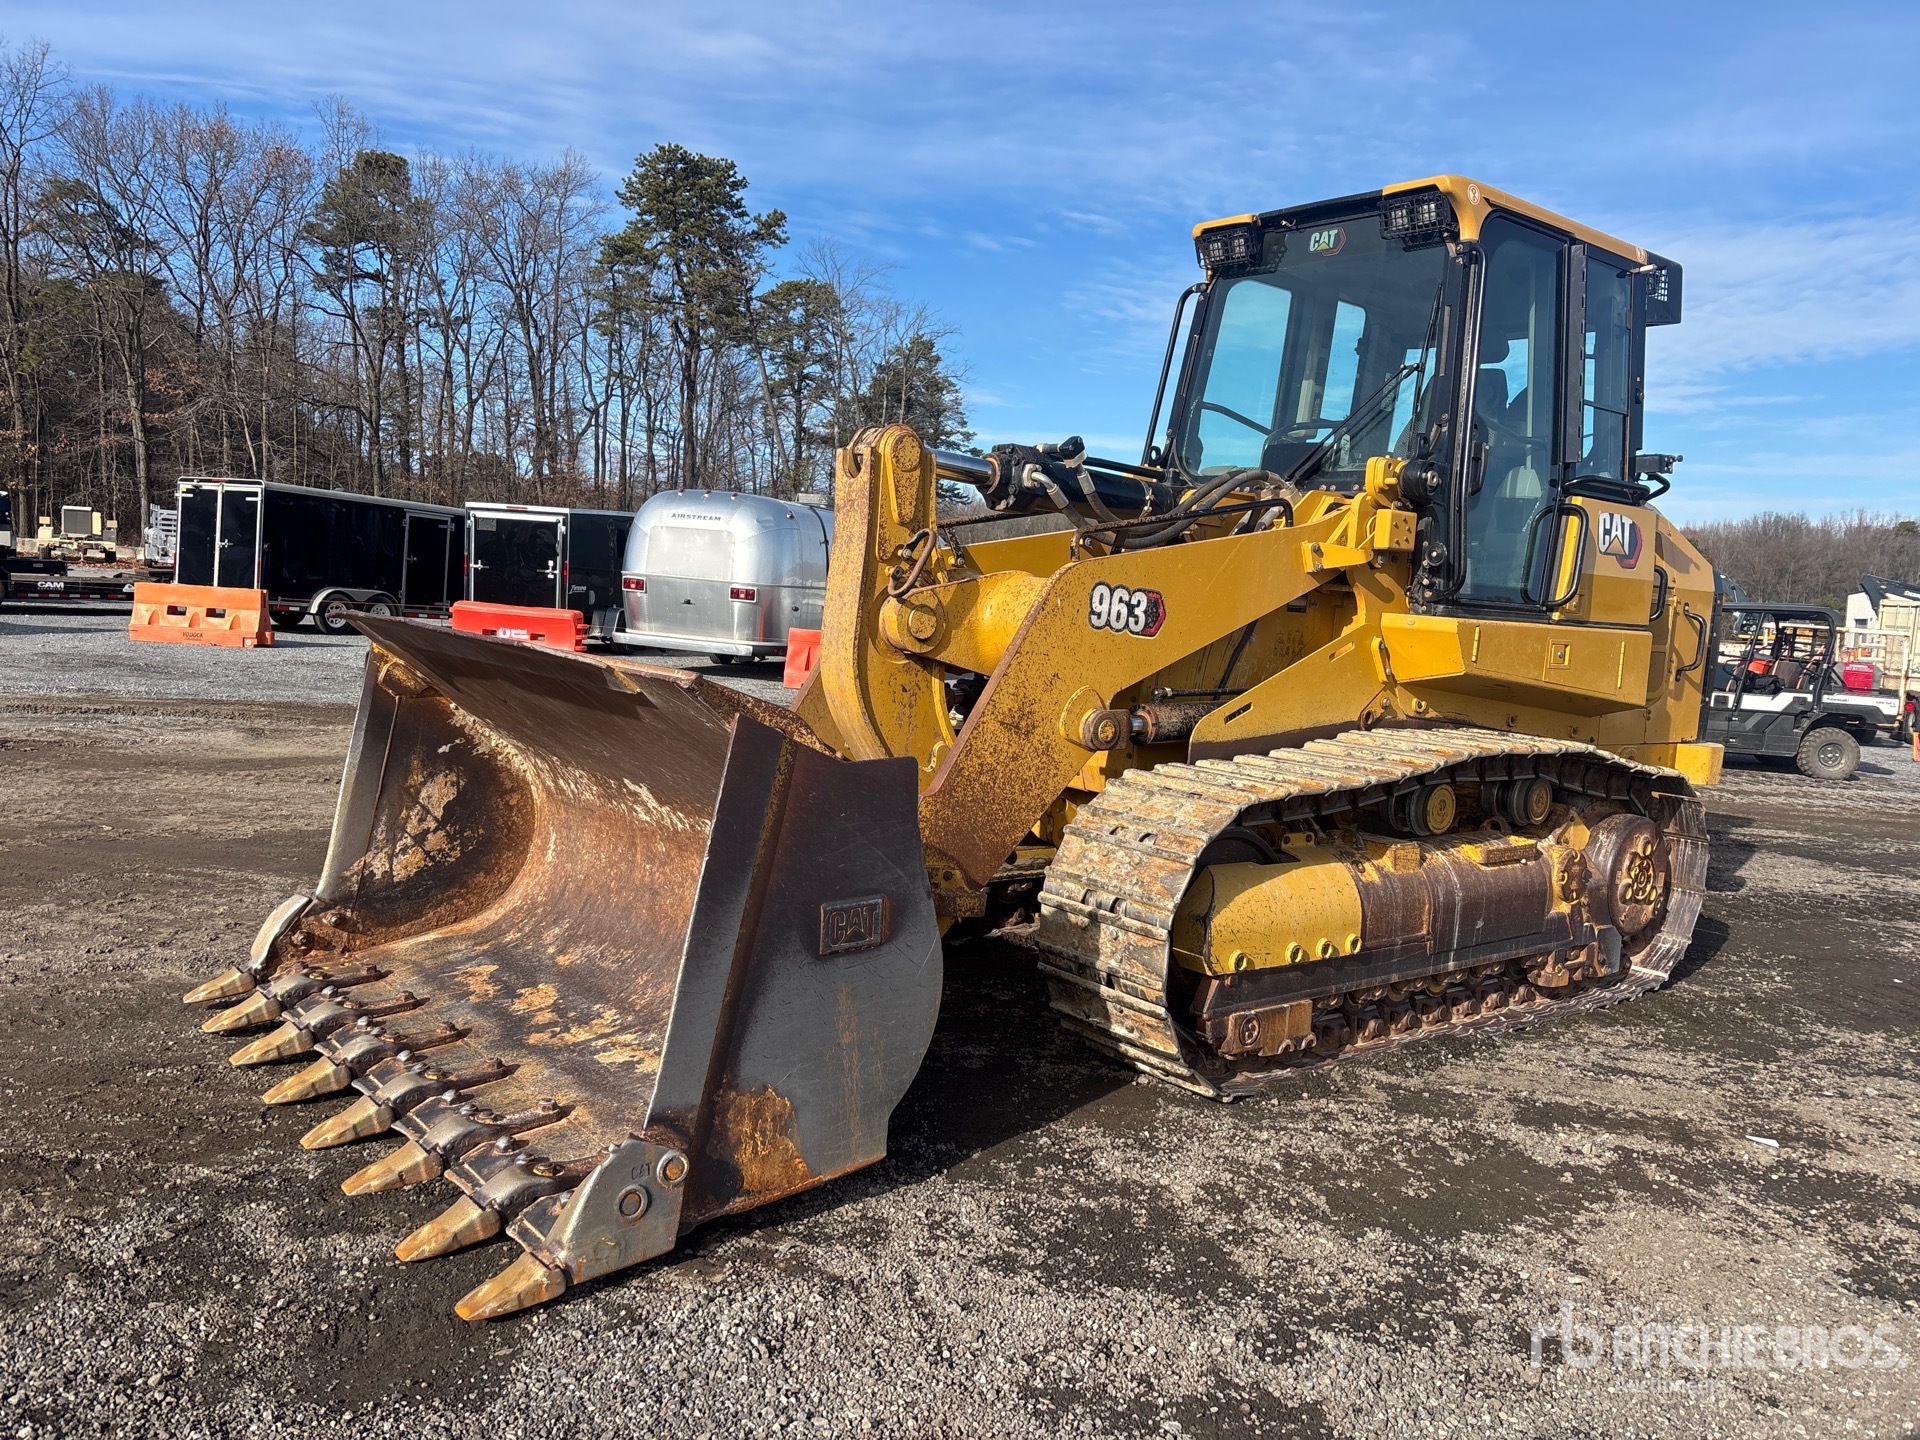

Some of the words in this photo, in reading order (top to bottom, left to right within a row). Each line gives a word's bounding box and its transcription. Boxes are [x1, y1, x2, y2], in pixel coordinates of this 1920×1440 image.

[1309, 229, 1338, 252] CAT
[671, 513, 722, 521] AIRSTREAM
[1598, 513, 1633, 556] CAT
[1090, 584, 1148, 633] 963
[828, 904, 879, 946] CAT
[631, 1161, 652, 1181] CAT
